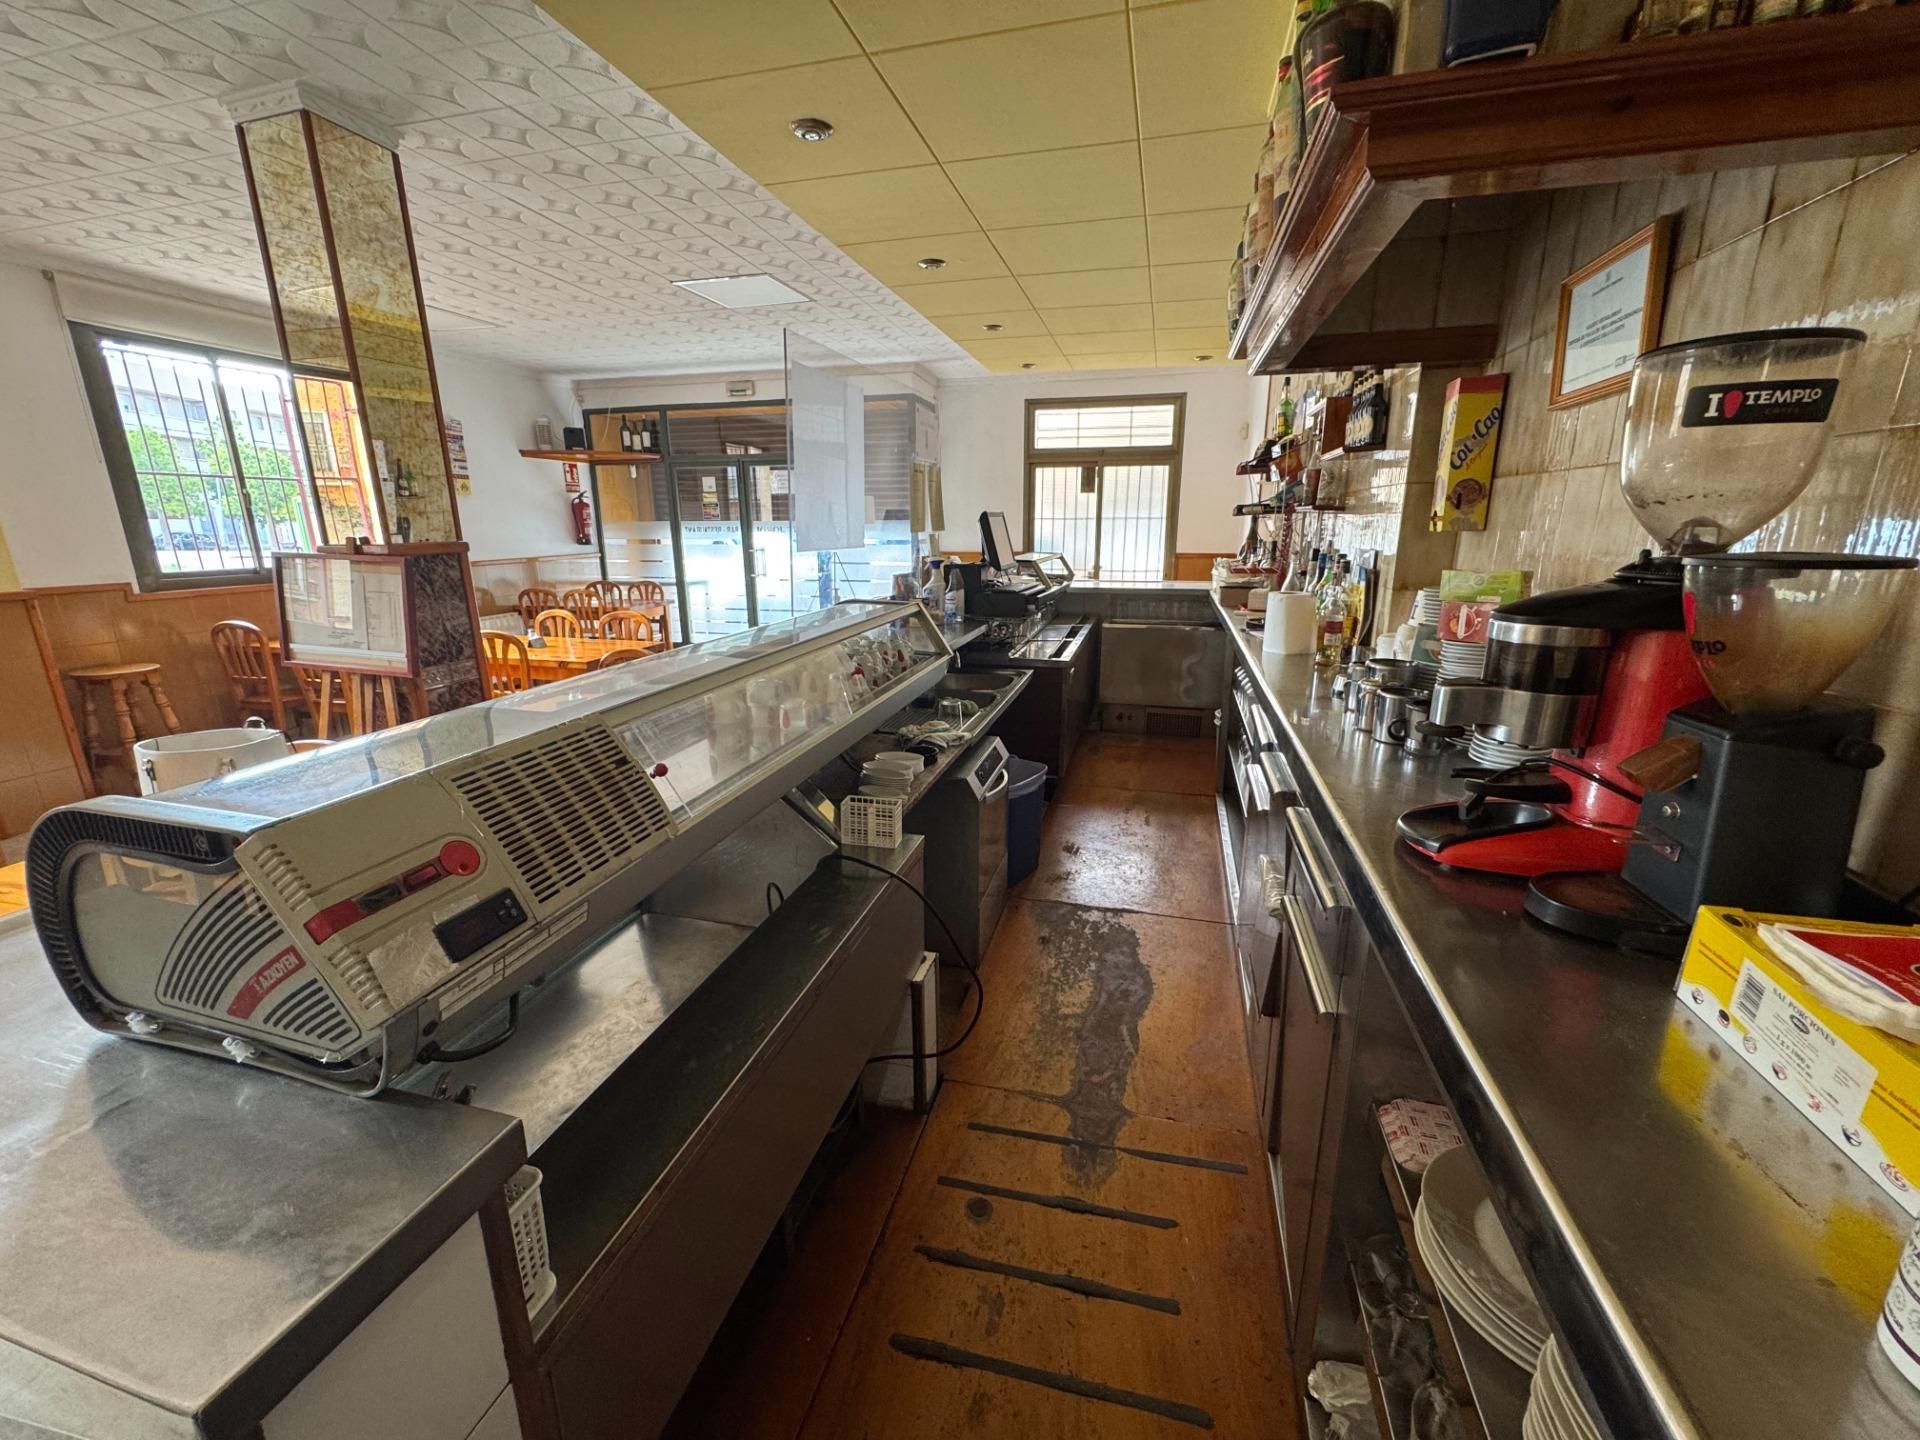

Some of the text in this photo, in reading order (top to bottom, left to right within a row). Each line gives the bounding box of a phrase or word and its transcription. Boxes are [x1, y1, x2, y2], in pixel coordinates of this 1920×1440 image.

[1704, 388, 1822, 417] I TEMPLO
[1773, 986, 1787, 1002] SAL
[1788, 1000, 1836, 1046] PORCIONES
